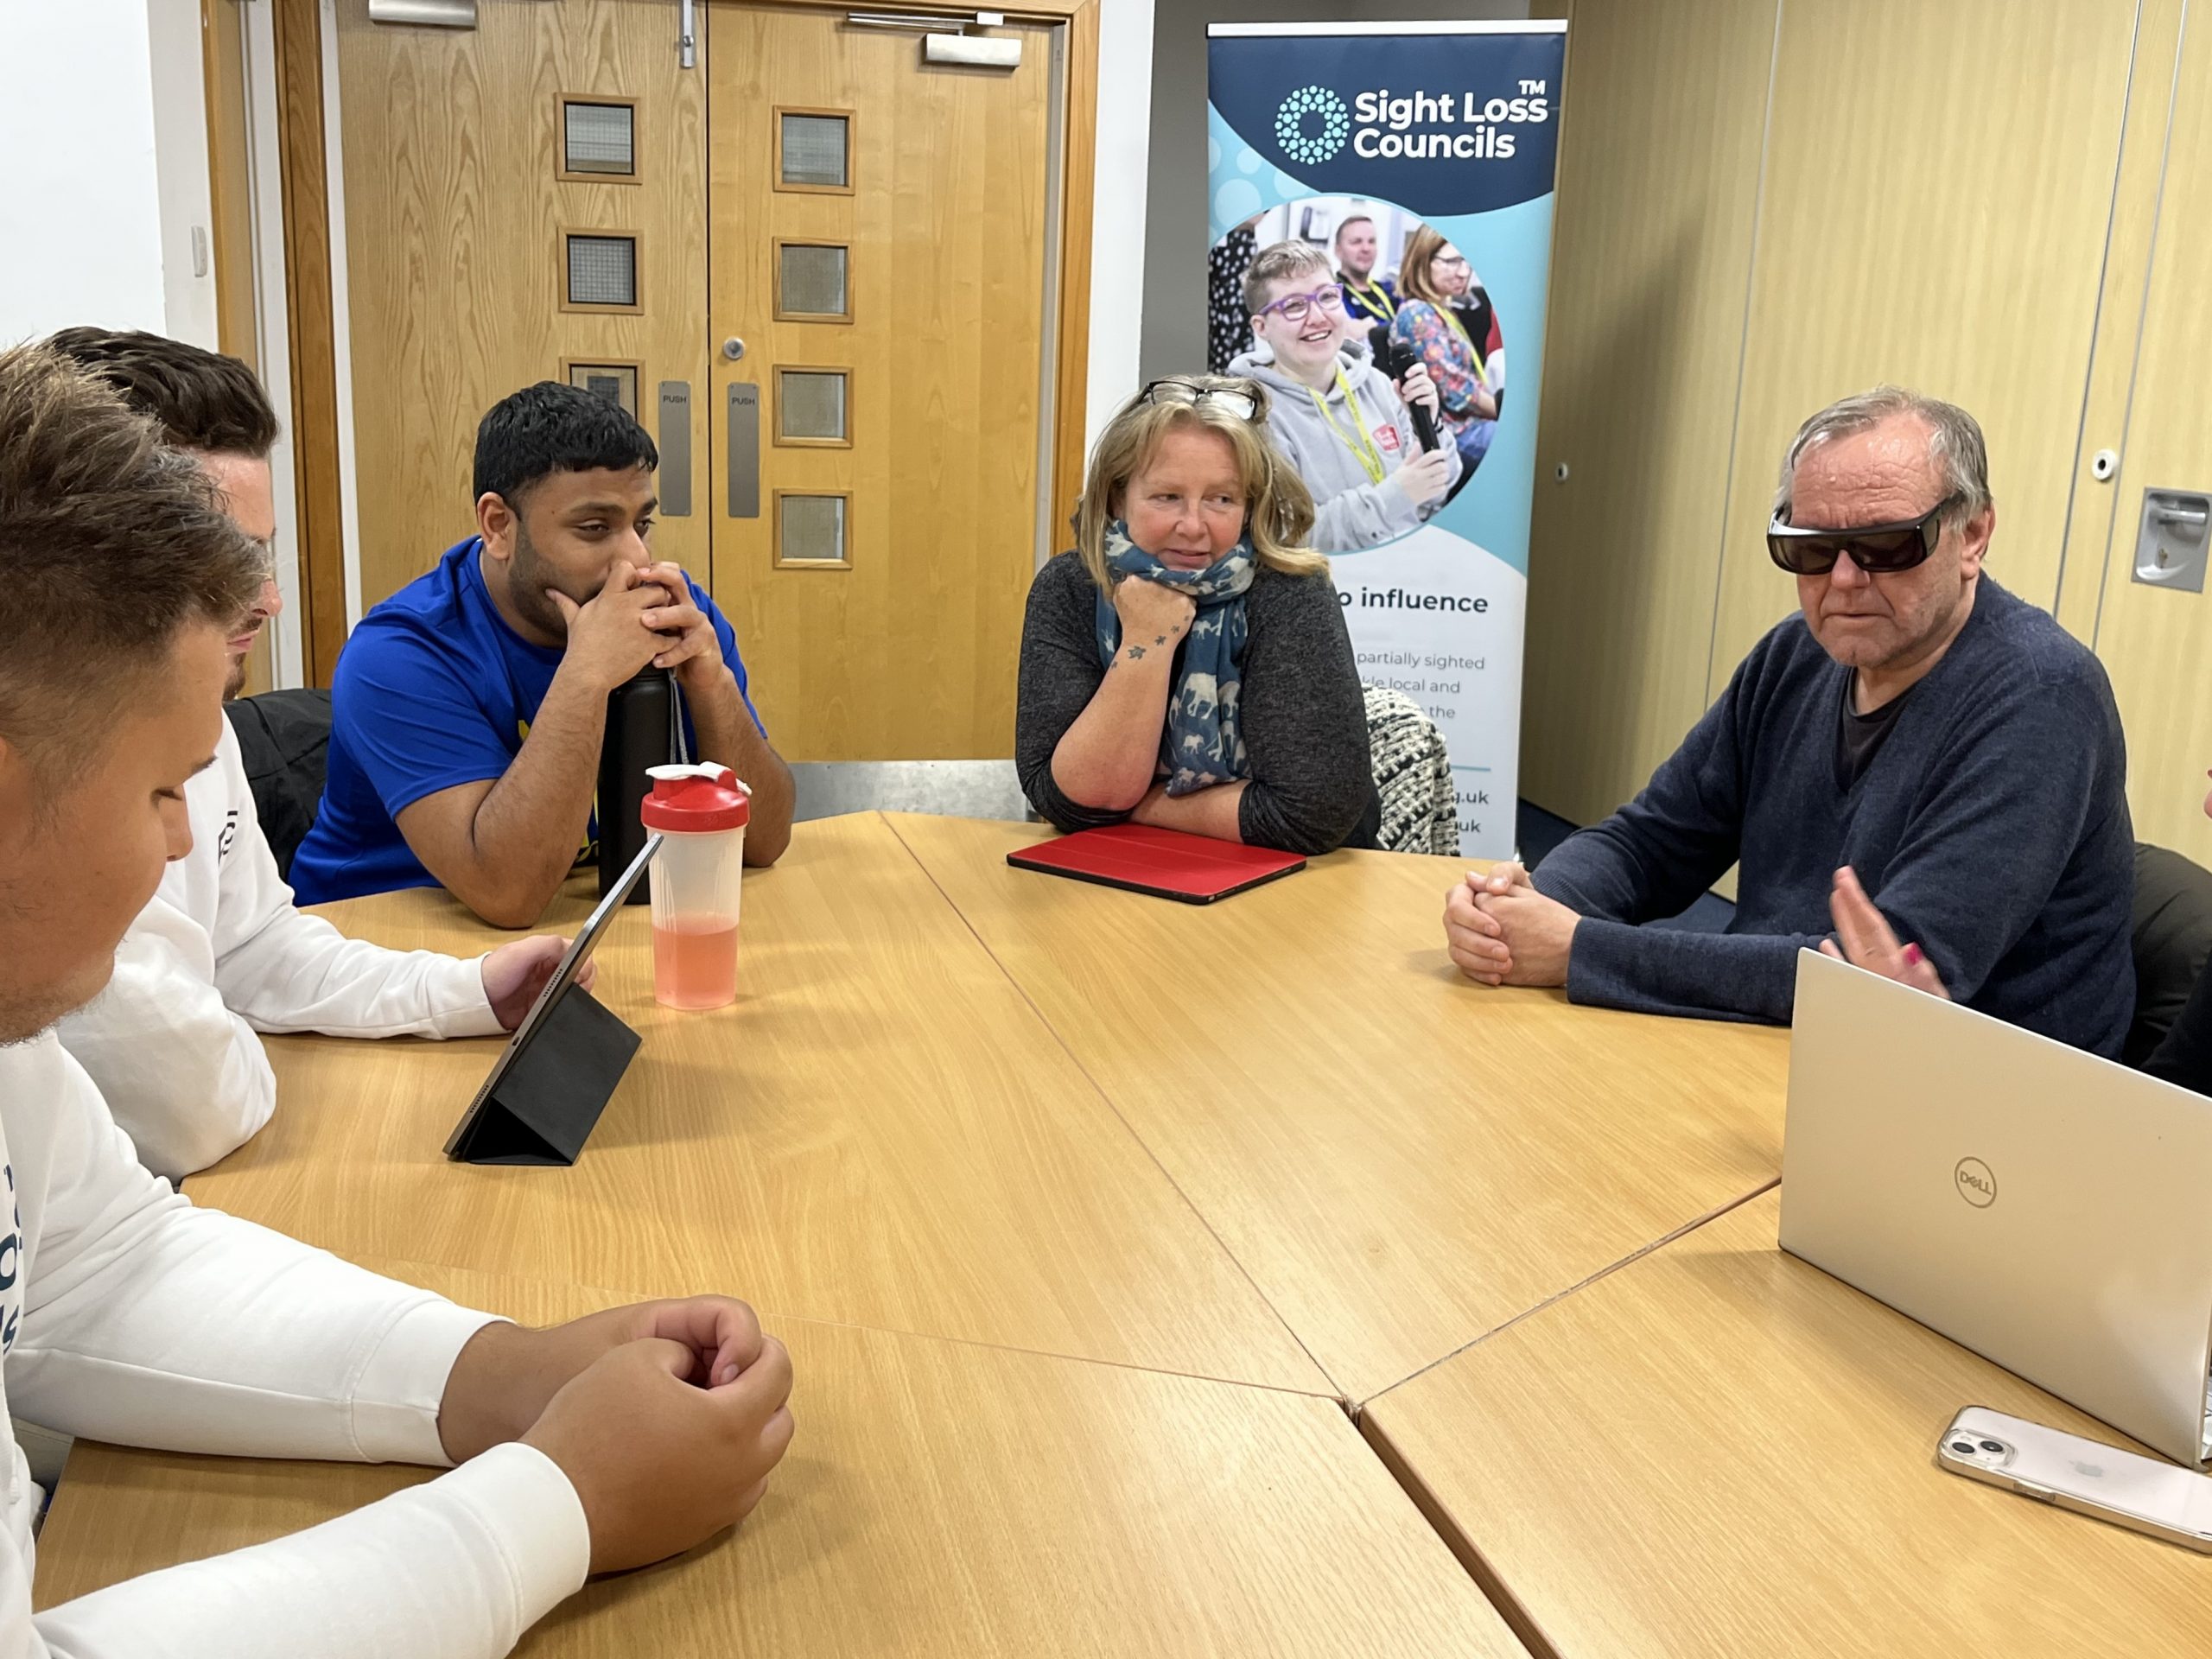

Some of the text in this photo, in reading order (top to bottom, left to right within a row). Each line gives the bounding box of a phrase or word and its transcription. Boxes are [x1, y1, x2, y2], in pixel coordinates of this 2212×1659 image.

[1518, 79, 1546, 95] TM
[1354, 89, 1548, 130] Sight Loss
[1353, 125, 1516, 159] Councils
[663, 395, 687, 404] PUSH
[732, 397, 755, 405] PUSH
[1338, 587, 1489, 613] o influence
[1357, 652, 1485, 671] partially sighted
[1362, 676, 1461, 694] kle local and
[1429, 705, 1456, 719] the
[1459, 819, 1481, 833] uk
[1959, 1170, 1993, 1196] DELL
